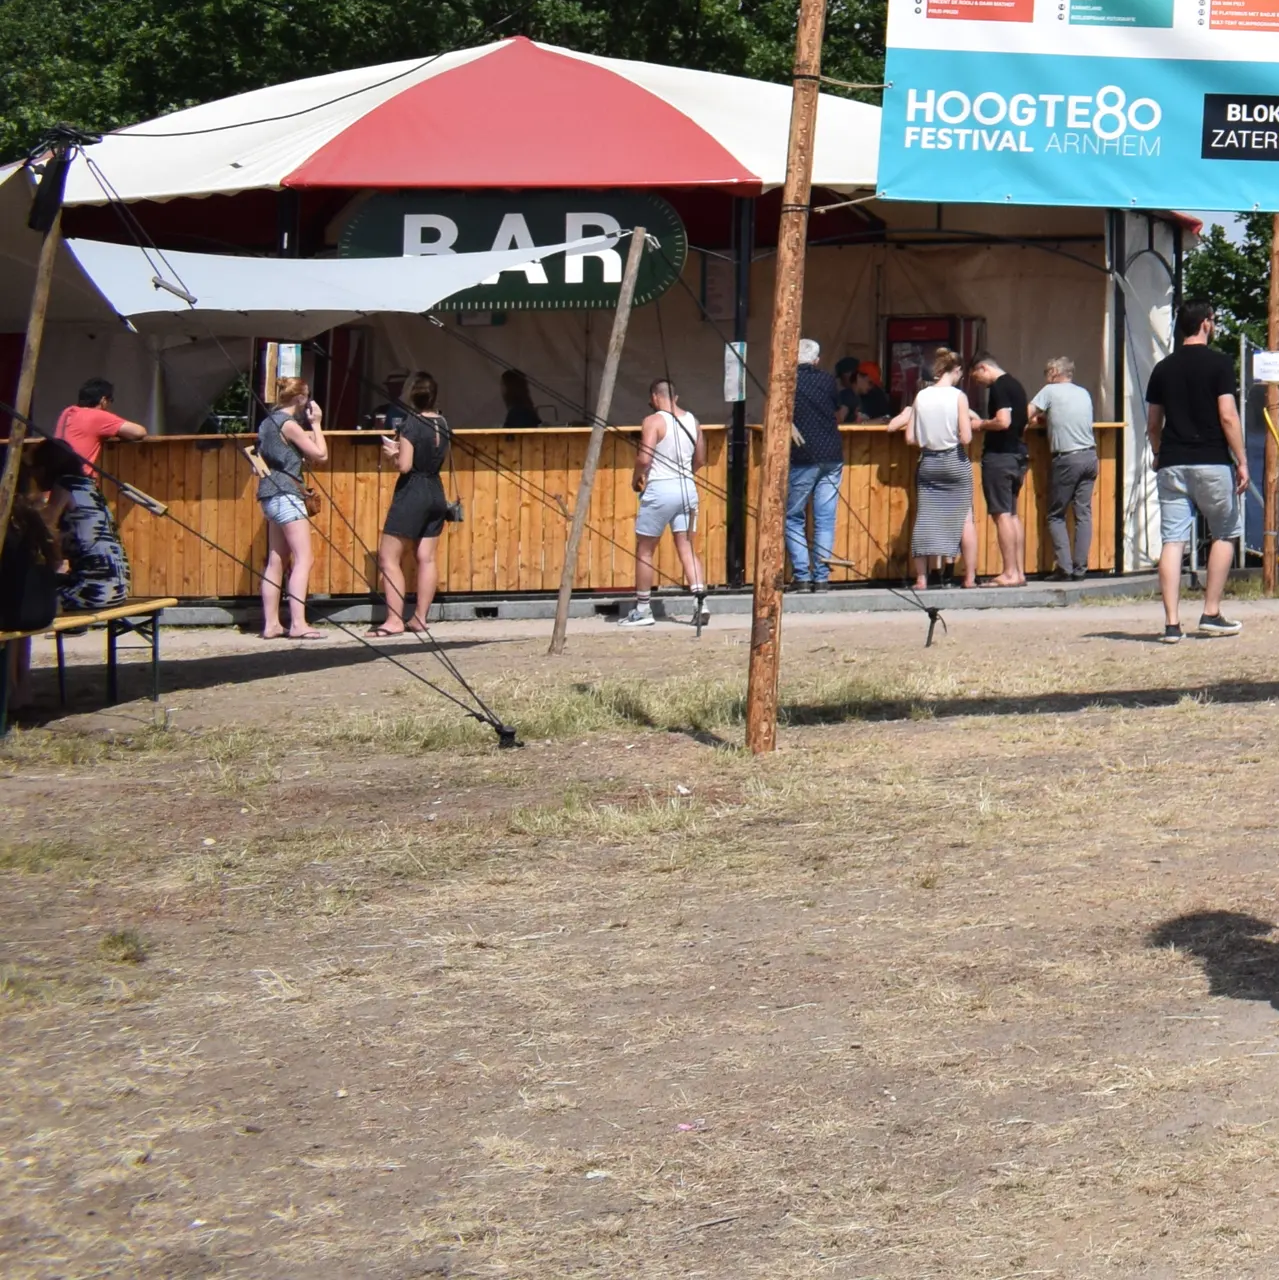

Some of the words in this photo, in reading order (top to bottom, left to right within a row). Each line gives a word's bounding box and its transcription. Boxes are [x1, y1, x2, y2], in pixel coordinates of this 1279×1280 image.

[906, 85, 1162, 140] HOOGTE80
[904, 127, 1034, 152] FESTIVAL
[1045, 132, 1161, 156] ARNHEM
[403, 212, 622, 284] BAR
